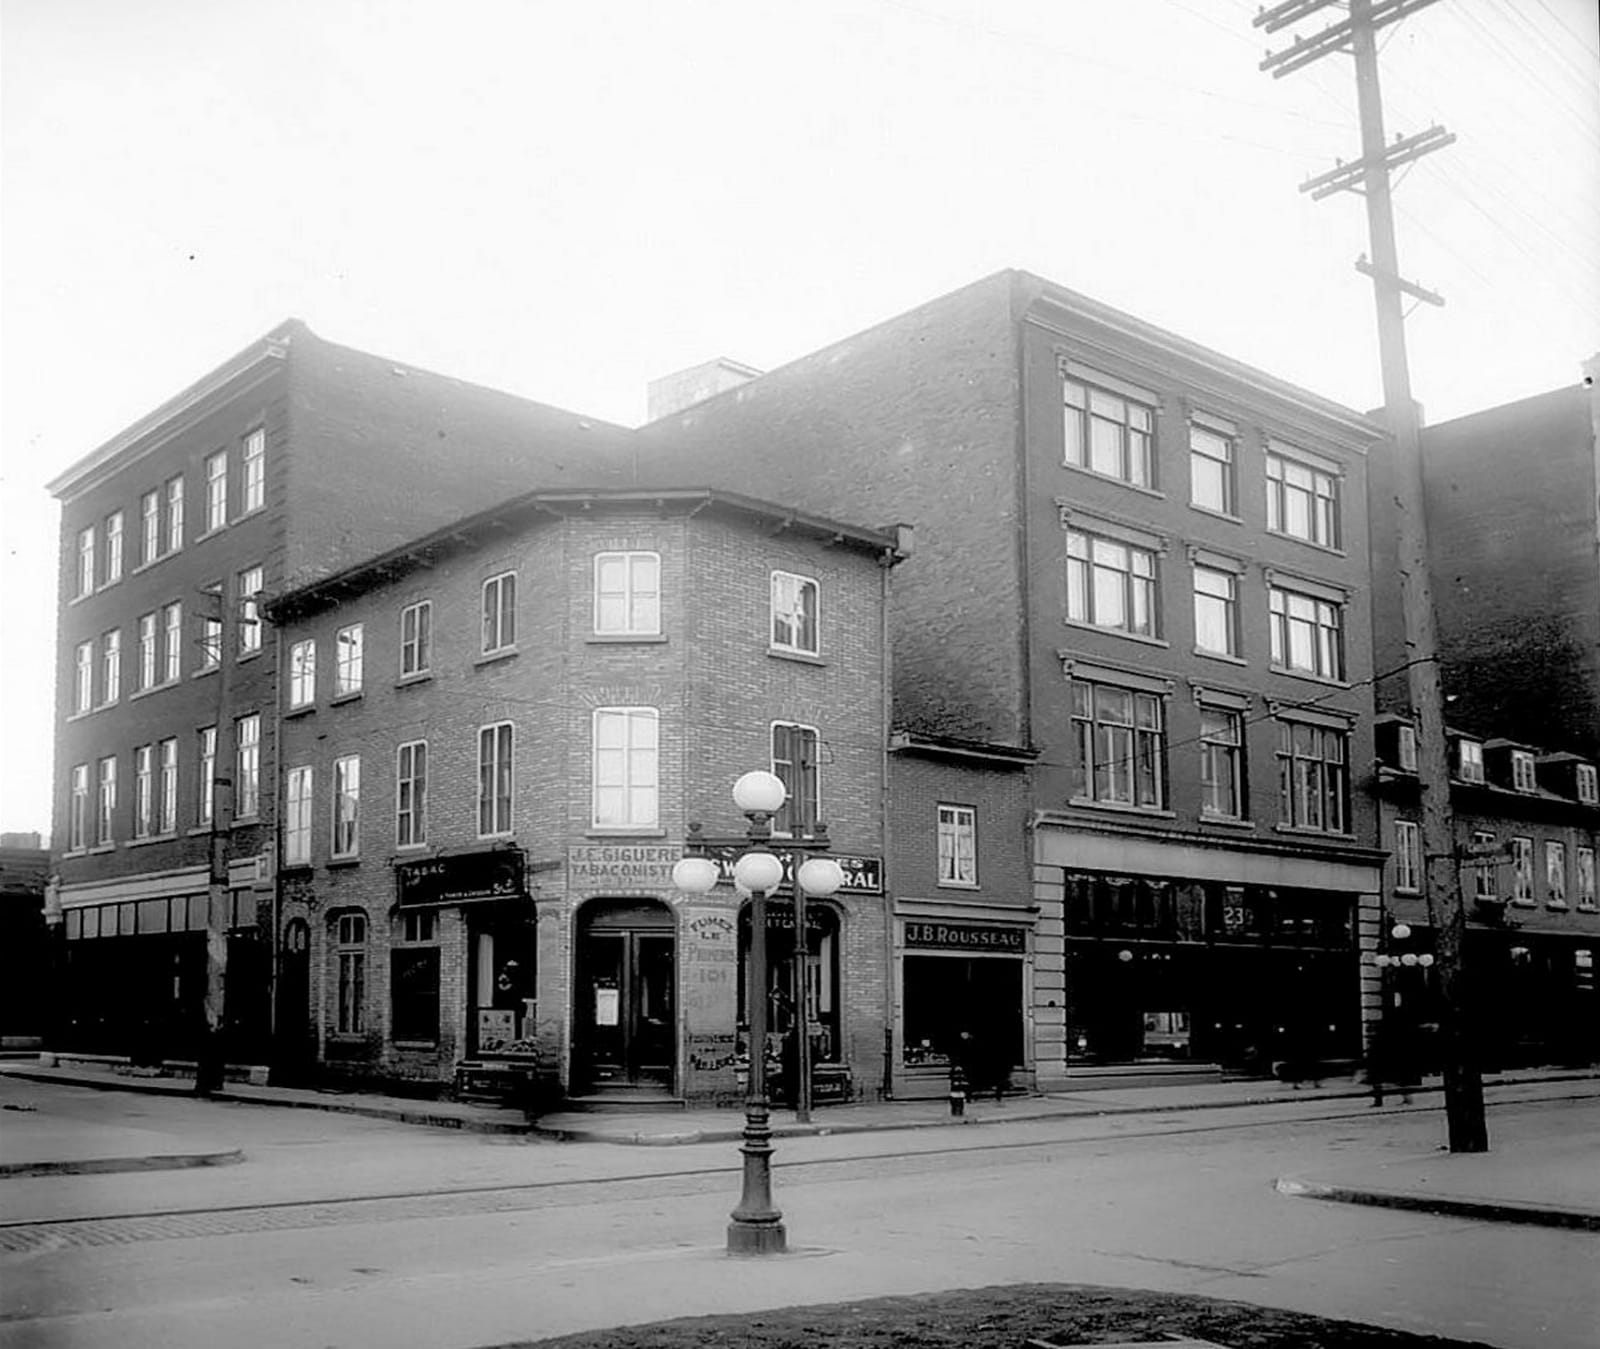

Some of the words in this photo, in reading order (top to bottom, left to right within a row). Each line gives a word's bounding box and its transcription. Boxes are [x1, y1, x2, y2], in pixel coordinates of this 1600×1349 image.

[602, 847, 681, 862] GIGUERE
[690, 916, 734, 933] FUMEZ
[702, 931, 720, 940] LE
